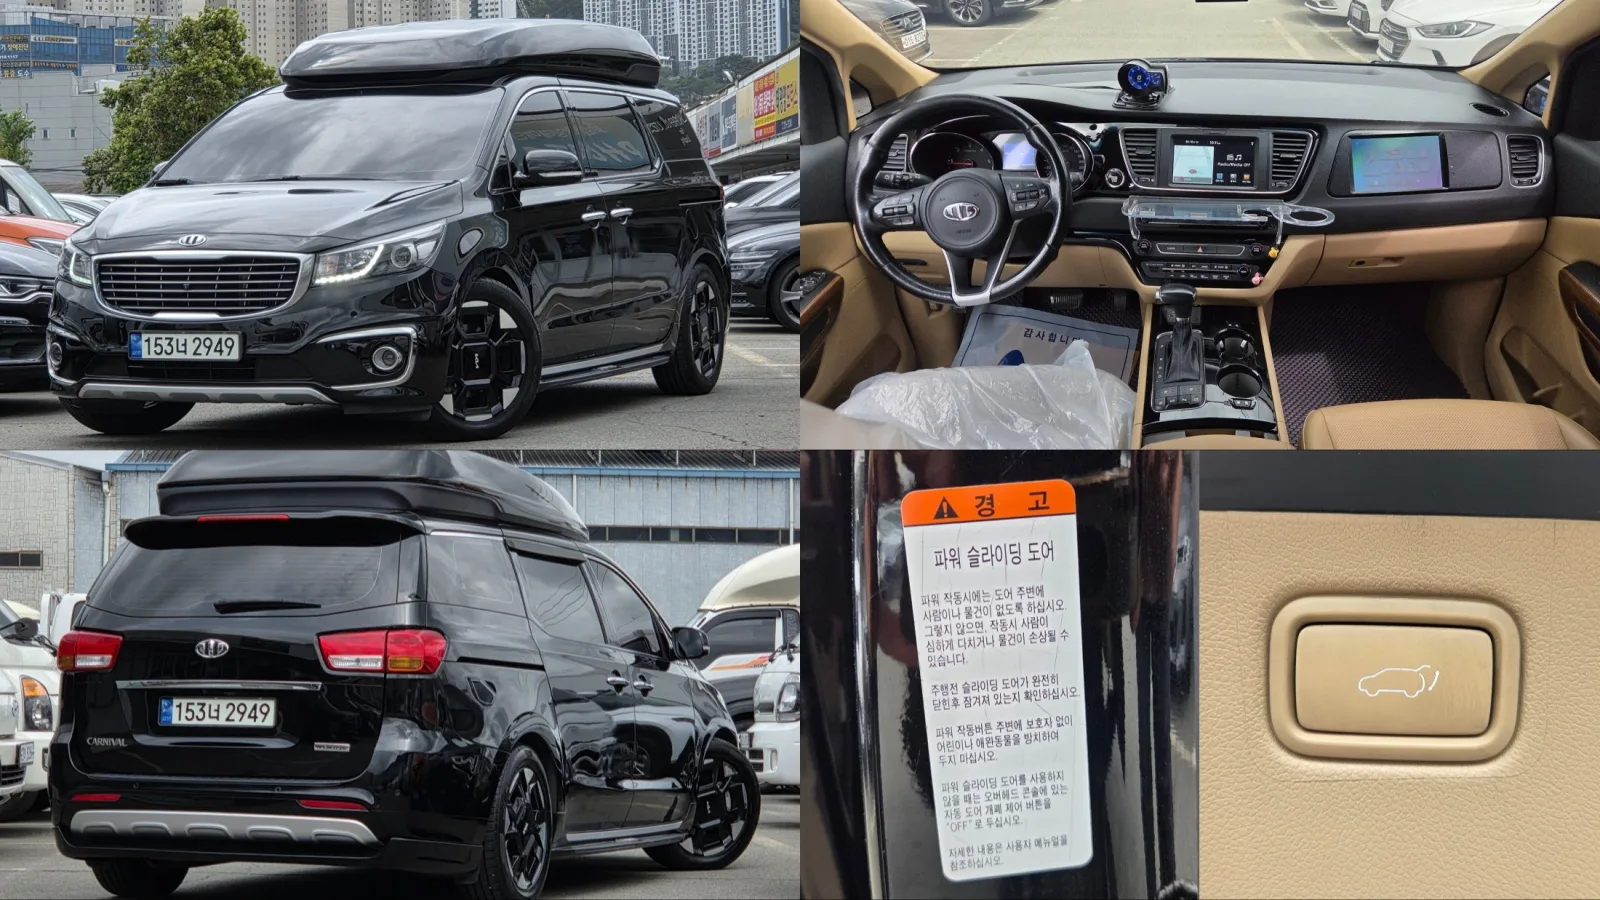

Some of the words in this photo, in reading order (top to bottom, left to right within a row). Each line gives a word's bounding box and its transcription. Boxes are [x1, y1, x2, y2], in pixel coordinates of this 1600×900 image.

[144, 337, 187, 355] 153너
[192, 337, 235, 356] 2949
[934, 548, 961, 570] 파워
[968, 542, 1021, 567] 슬라이딩
[1028, 540, 1054, 562] 도어
[921, 594, 939, 607] 파워
[944, 590, 991, 604] 작동시에는
[995, 587, 1012, 601] 도어
[1016, 584, 1044, 599] 주변에
[923, 608, 961, 623] 사람이나
[964, 605, 992, 620] 물건이
[995, 602, 1023, 617] 없도록
[1027, 599, 1067, 613] 하십시오.
[925, 624, 952, 638] 그렇지
[990, 618, 1017, 632] 작동시
[1021, 616, 1048, 630] 사람이
[926, 639, 954, 653] 심하게
[958, 635, 994, 650] 다치거나
[998, 632, 1026, 647] 물건이
[1029, 630, 1056, 644] 손상될
[1060, 629, 1069, 641] 수
[927, 653, 968, 668] 있습니다.
[931, 683, 958, 696] 주행전
[962, 679, 998, 694] 슬라이딩
[1002, 676, 1028, 690] 도어가
[1032, 673, 1058, 687] 완전히
[963, 694, 990, 708] 잠겨져
[994, 691, 1020, 705] 있는지
[175, 702, 220, 721] 153너
[225, 703, 271, 723] 2949
[936, 727, 953, 739] 파워
[957, 723, 993, 737] 작동버튼
[996, 719, 1023, 734] 주변에
[1026, 717, 1052, 731] 보호자
[1056, 714, 1073, 727] 없이
[86, 736, 128, 747] CARNIVAL
[936, 739, 973, 753] 어린이나
[976, 734, 1020, 749] 애완동물을
[1024, 731, 1059, 744] 방치하여
[938, 754, 956, 766] 두지
[960, 751, 997, 764] 마십시오.
[941, 781, 959, 793] 파워
[963, 776, 997, 791] 슬라이딩
[1001, 773, 1026, 787] 도어를
[1030, 770, 1064, 784] 사용하지
[984, 787, 1018, 803] 오버헤드
[1051, 783, 1067, 796] 있는
[944, 808, 961, 820] 자동
[965, 806, 982, 817] 도어
[1006, 800, 1023, 813] 제어
[986, 815, 1023, 828] 두십시오.
[949, 845, 974, 859] 자세한
[978, 842, 1002, 856] 내용은
[1006, 838, 1032, 852] 사용자
